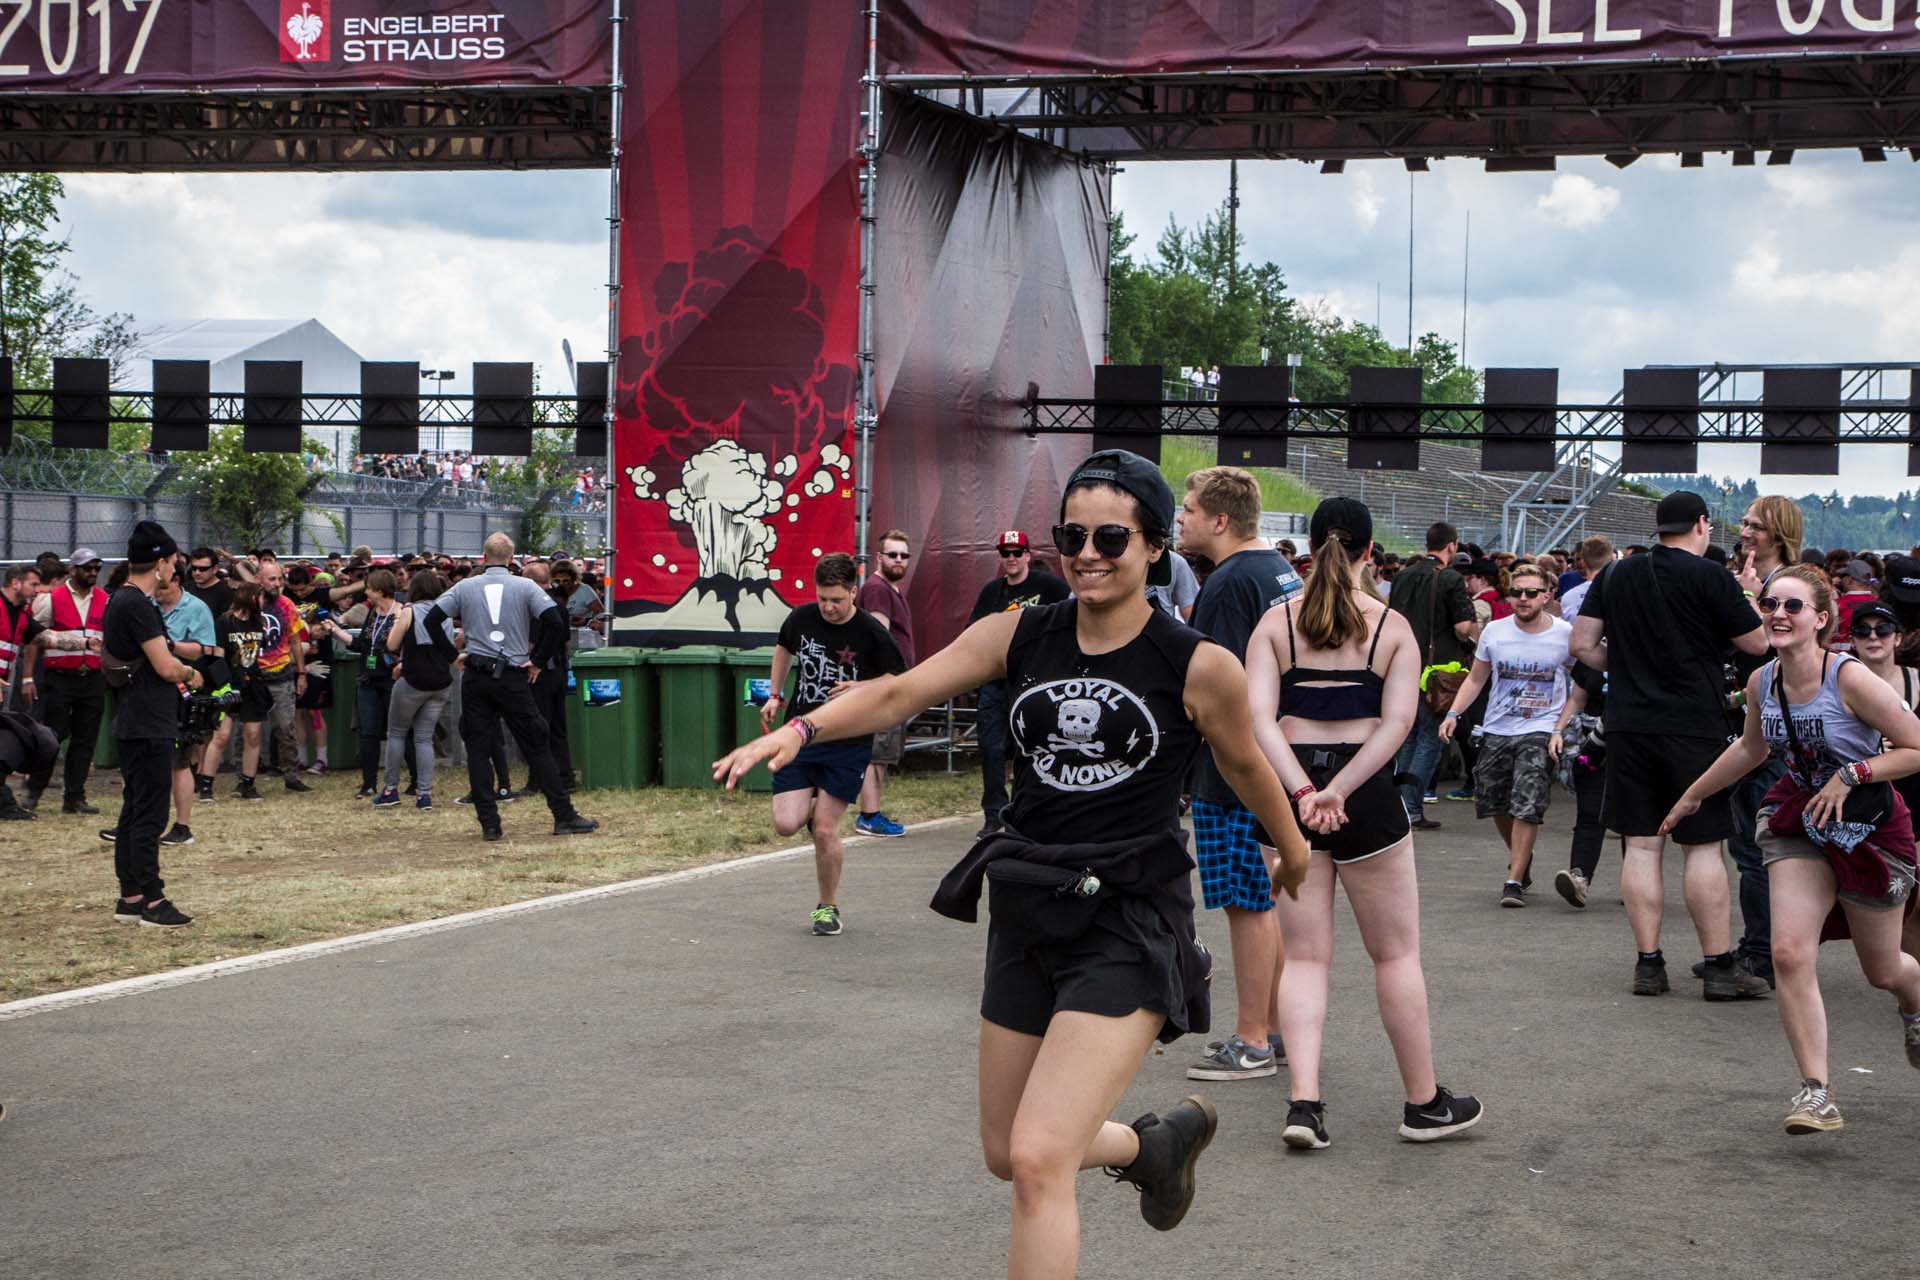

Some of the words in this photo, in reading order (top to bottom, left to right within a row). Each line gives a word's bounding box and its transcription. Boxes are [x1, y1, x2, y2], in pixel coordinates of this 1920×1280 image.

[343, 14, 505, 36] ENGELBERT
[0, 0, 162, 75] 2017
[343, 37, 505, 62] STRAUSS
[800, 634, 826, 657] DIE
[797, 680, 831, 704] HOS
[1045, 681, 1126, 712] LOYAL
[1791, 718, 1825, 738] INGER
[1059, 758, 1131, 785] NONE
